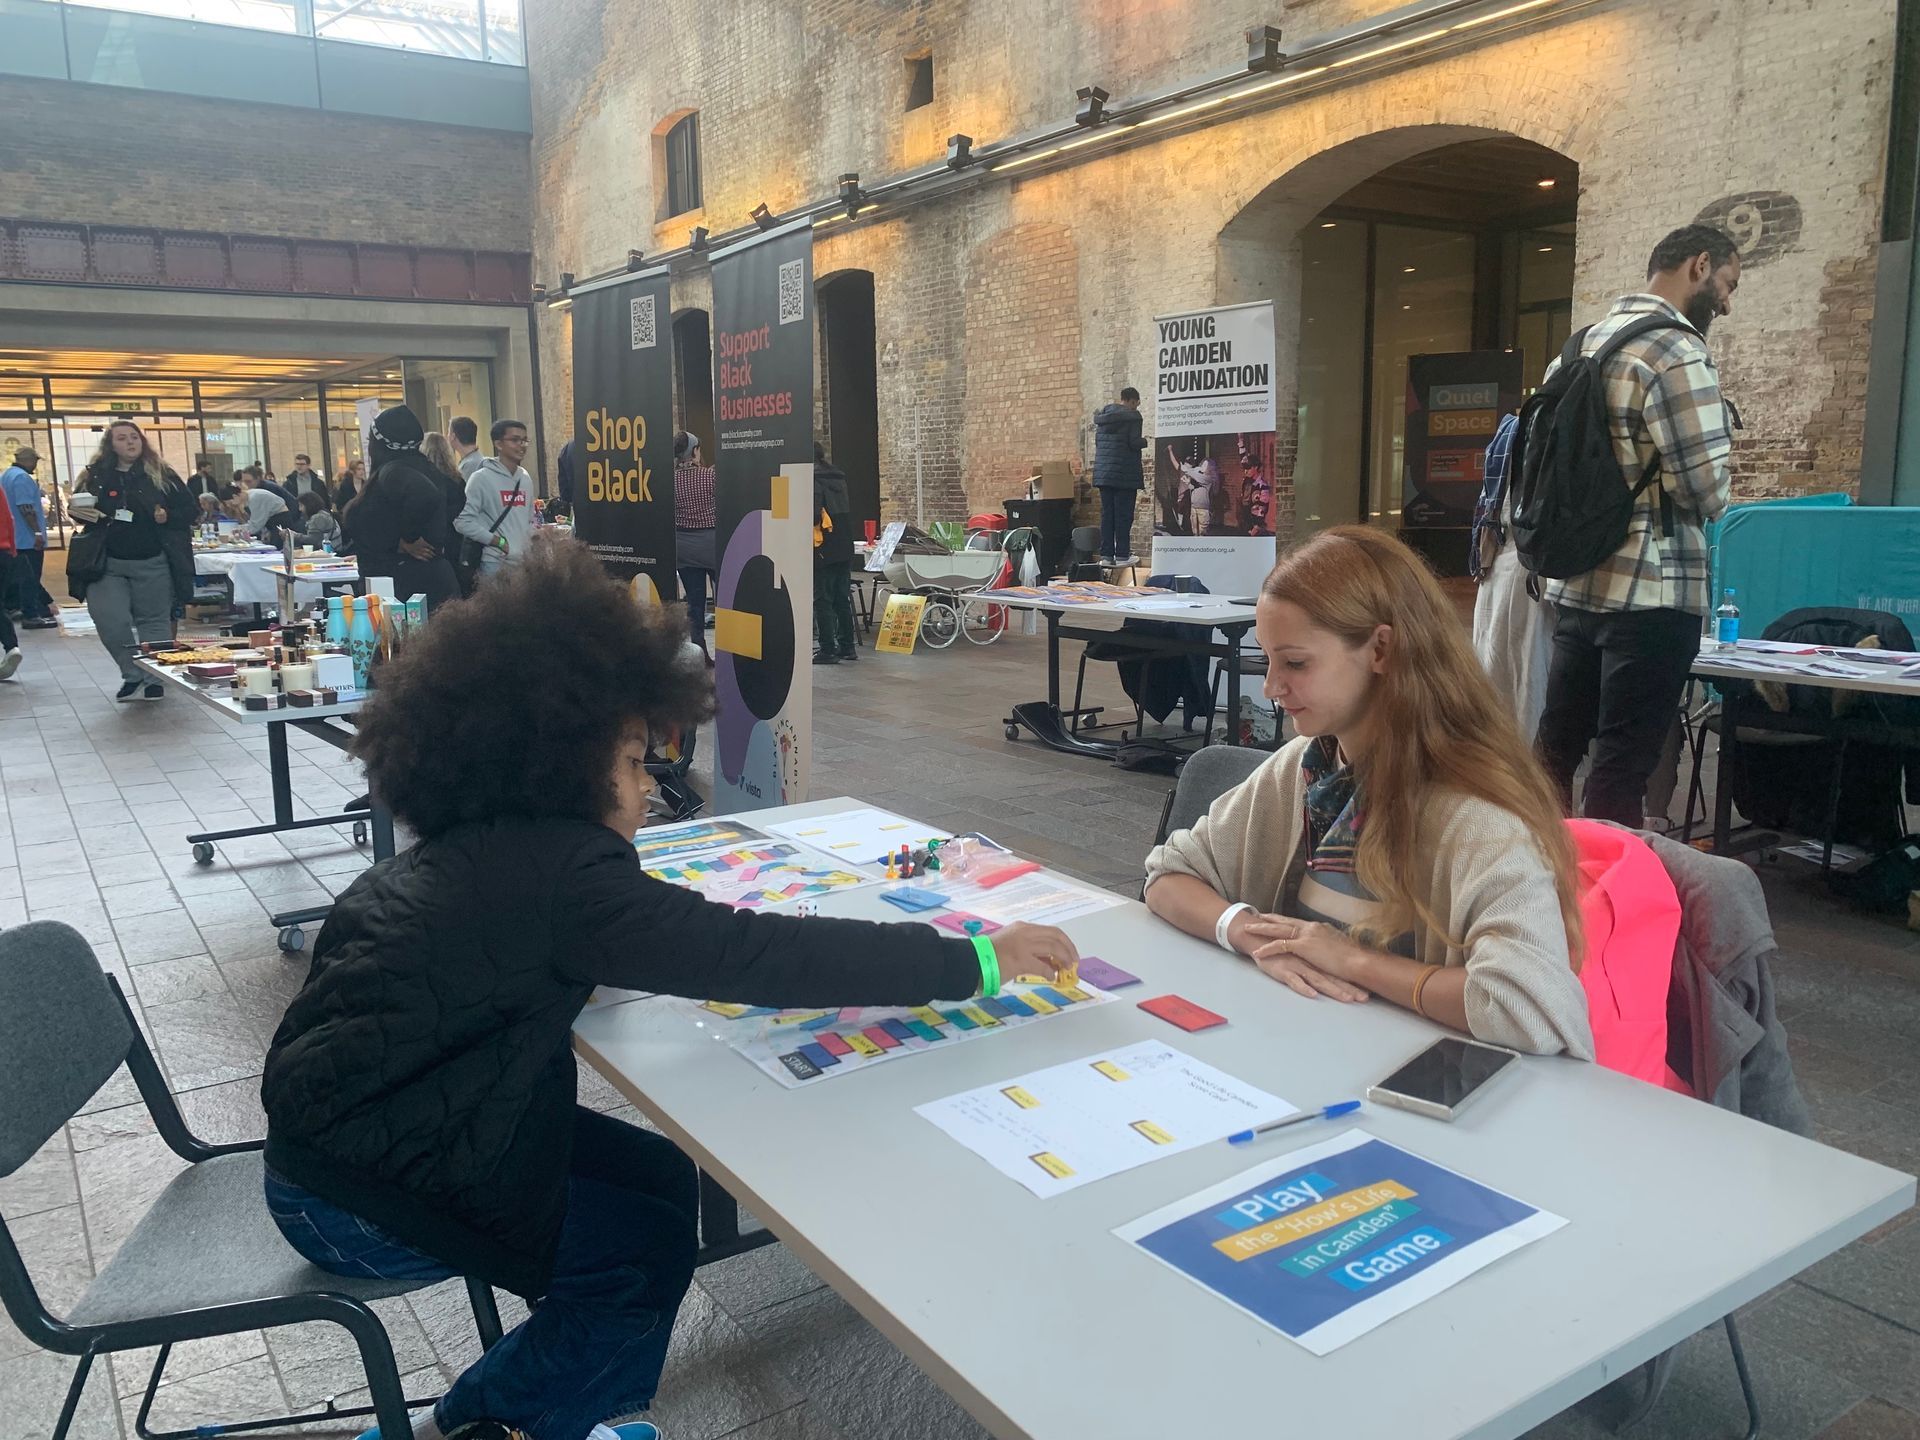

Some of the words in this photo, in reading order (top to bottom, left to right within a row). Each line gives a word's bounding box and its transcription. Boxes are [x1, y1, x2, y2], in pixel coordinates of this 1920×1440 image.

[1726, 204, 1763, 255] 9
[720, 324, 770, 359] Support
[1159, 316, 1215, 343] YOUNG
[1159, 341, 1231, 369] CAMDEN
[720, 361, 752, 390] Black
[1158, 364, 1269, 394] FOUNDATION
[720, 392, 792, 421] Businesses
[1166, 404, 1180, 412] Young
[1181, 402, 1203, 411] Camden
[1204, 401, 1233, 409] Foundation
[1437, 389, 1491, 405] Quiet
[1176, 420, 1192, 428] young
[1187, 410, 1225, 418] opportunities
[1434, 414, 1491, 433] Space
[586, 407, 647, 461] Shop
[587, 457, 653, 503] Black
[1858, 595, 1873, 608] WE
[1875, 597, 1892, 612] ARE
[745, 781, 762, 799] vista
[783, 1055, 814, 1076] START
[1233, 1180, 1323, 1222] Play
[1235, 1230, 1279, 1251] the
[1352, 1187, 1397, 1206] Life
[1293, 1254, 1325, 1270] in
[1344, 1233, 1441, 1283] Game
